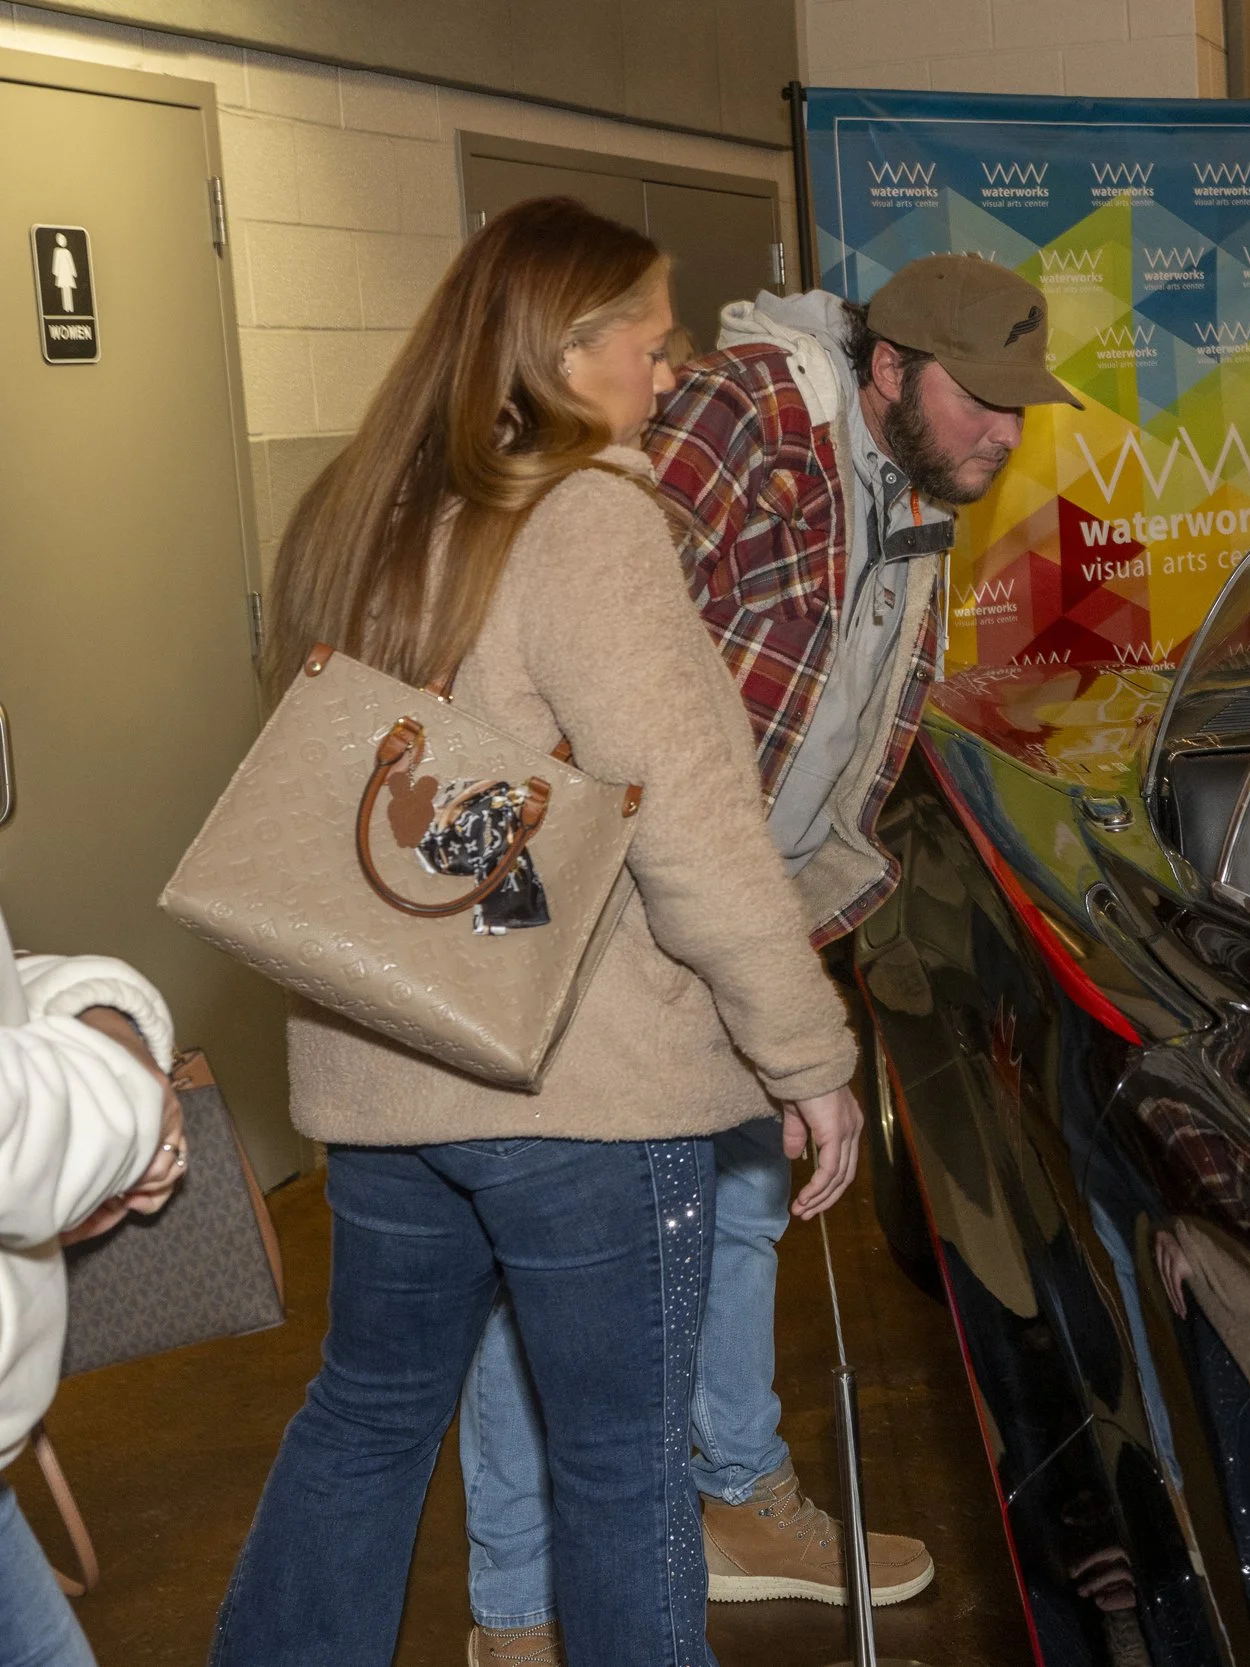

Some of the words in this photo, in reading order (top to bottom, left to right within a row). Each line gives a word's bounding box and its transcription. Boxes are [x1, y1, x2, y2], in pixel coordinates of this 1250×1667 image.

[870, 186, 939, 198] waterworks
[982, 186, 1049, 198] waterworks
[1091, 186, 1154, 197] waterworks
[872, 200, 893, 208] visual
[896, 200, 912, 208] arts
[915, 199, 939, 207] center
[982, 199, 1005, 208] visual
[1007, 200, 1023, 208] arts
[1025, 200, 1049, 208] center
[1040, 271, 1103, 284] waterworks
[1144, 269, 1205, 281] waterworks
[48, 324, 92, 340] WOMEN
[1097, 347, 1158, 359] waterworks
[1082, 546, 1152, 582] visual
[1163, 550, 1207, 574] arts
[954, 602, 1017, 618] waterworks
